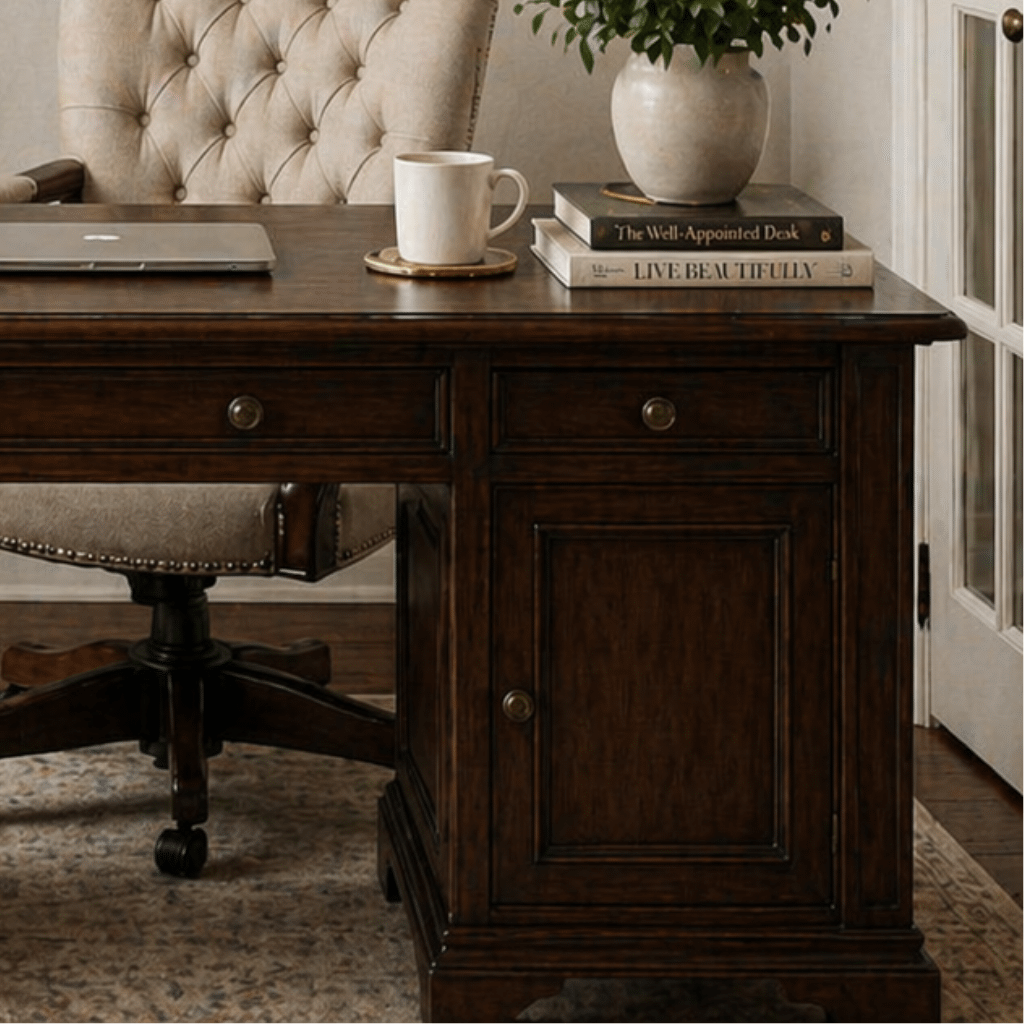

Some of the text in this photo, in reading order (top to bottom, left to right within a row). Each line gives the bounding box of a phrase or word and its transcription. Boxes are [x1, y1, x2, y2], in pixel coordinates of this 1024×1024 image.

[614, 223, 644, 241] The
[634, 262, 681, 280] LIVE
[685, 262, 818, 280] BEAUTIFULLY
